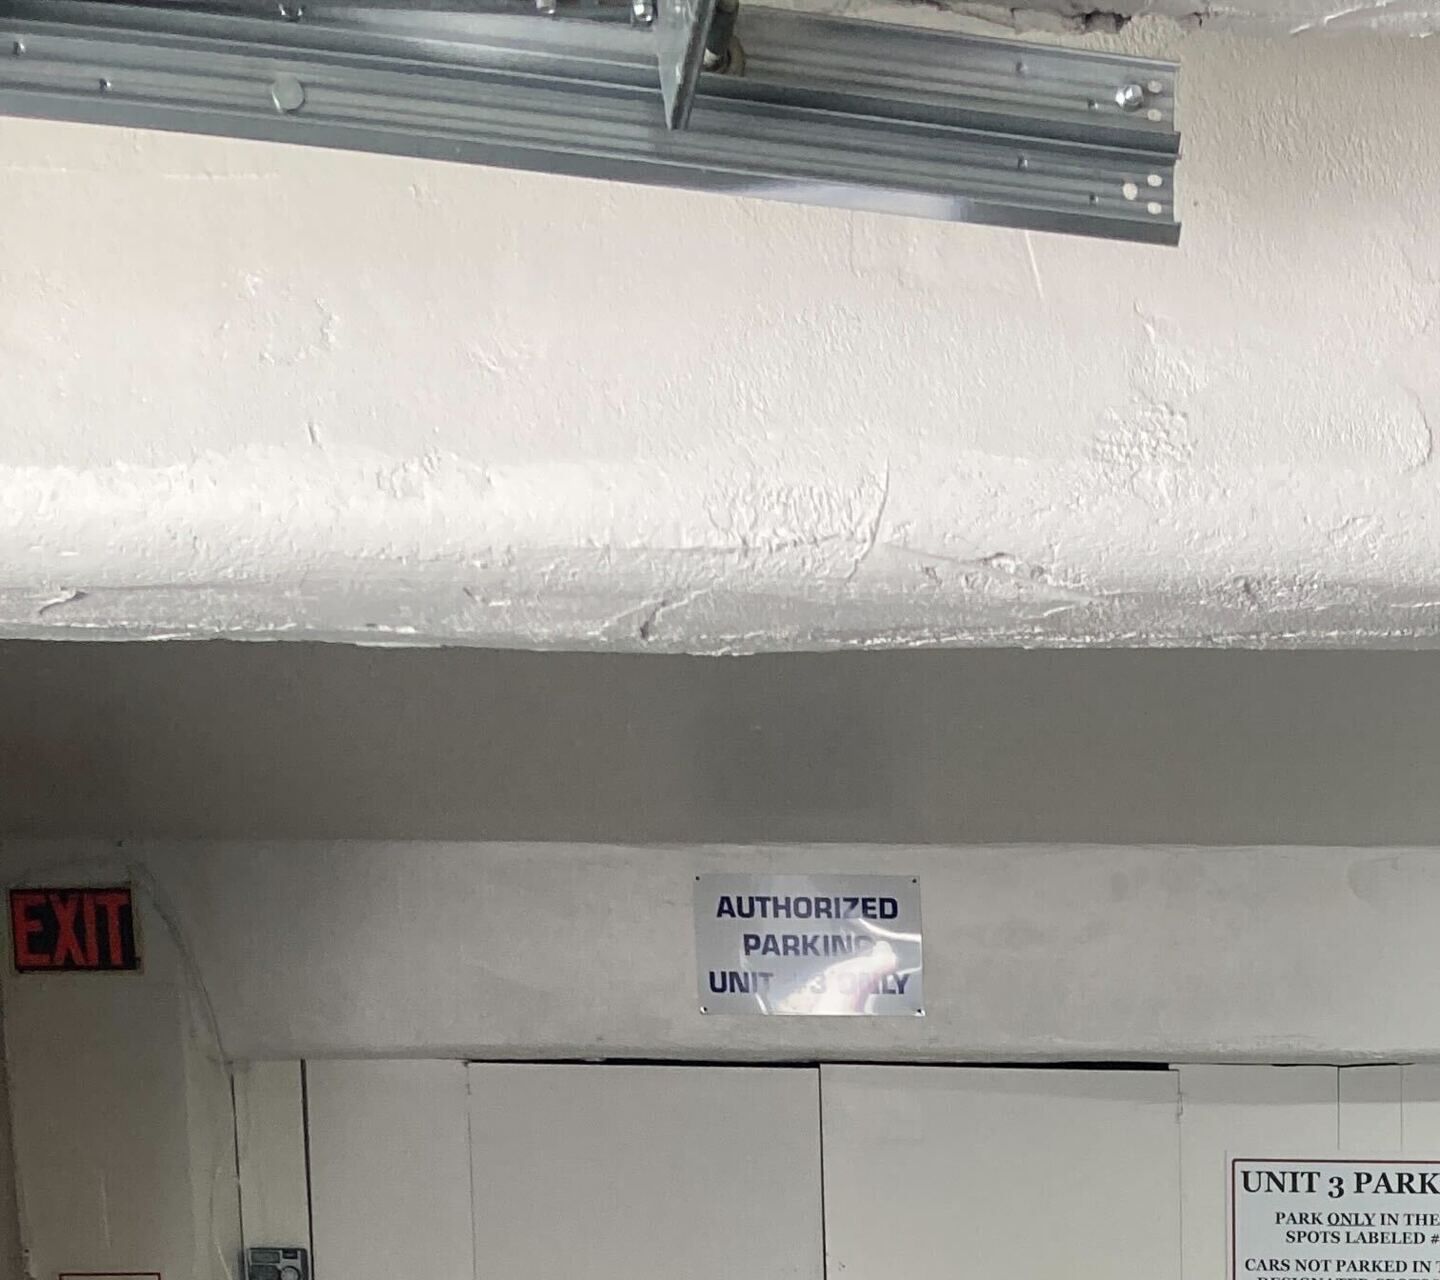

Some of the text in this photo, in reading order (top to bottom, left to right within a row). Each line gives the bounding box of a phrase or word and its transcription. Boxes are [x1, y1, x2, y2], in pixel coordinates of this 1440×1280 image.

[717, 896, 898, 919] AUTHORIZED
[12, 893, 129, 967] EXIT
[709, 971, 774, 994] UNIT
[1241, 1170, 1321, 1193] UNIT
[1328, 1176, 1345, 1199] 3
[1275, 1212, 1323, 1226] PARK
[1327, 1212, 1375, 1227] ONLY
[1380, 1213, 1398, 1226] IN
[1285, 1230, 1341, 1244] SPOTS
[1346, 1231, 1426, 1245] LABELED
[1245, 1258, 1290, 1272] CARS
[1295, 1259, 1331, 1273] NOT
[1336, 1259, 1408, 1273] PARKED
[1412, 1260, 1431, 1273] IN
